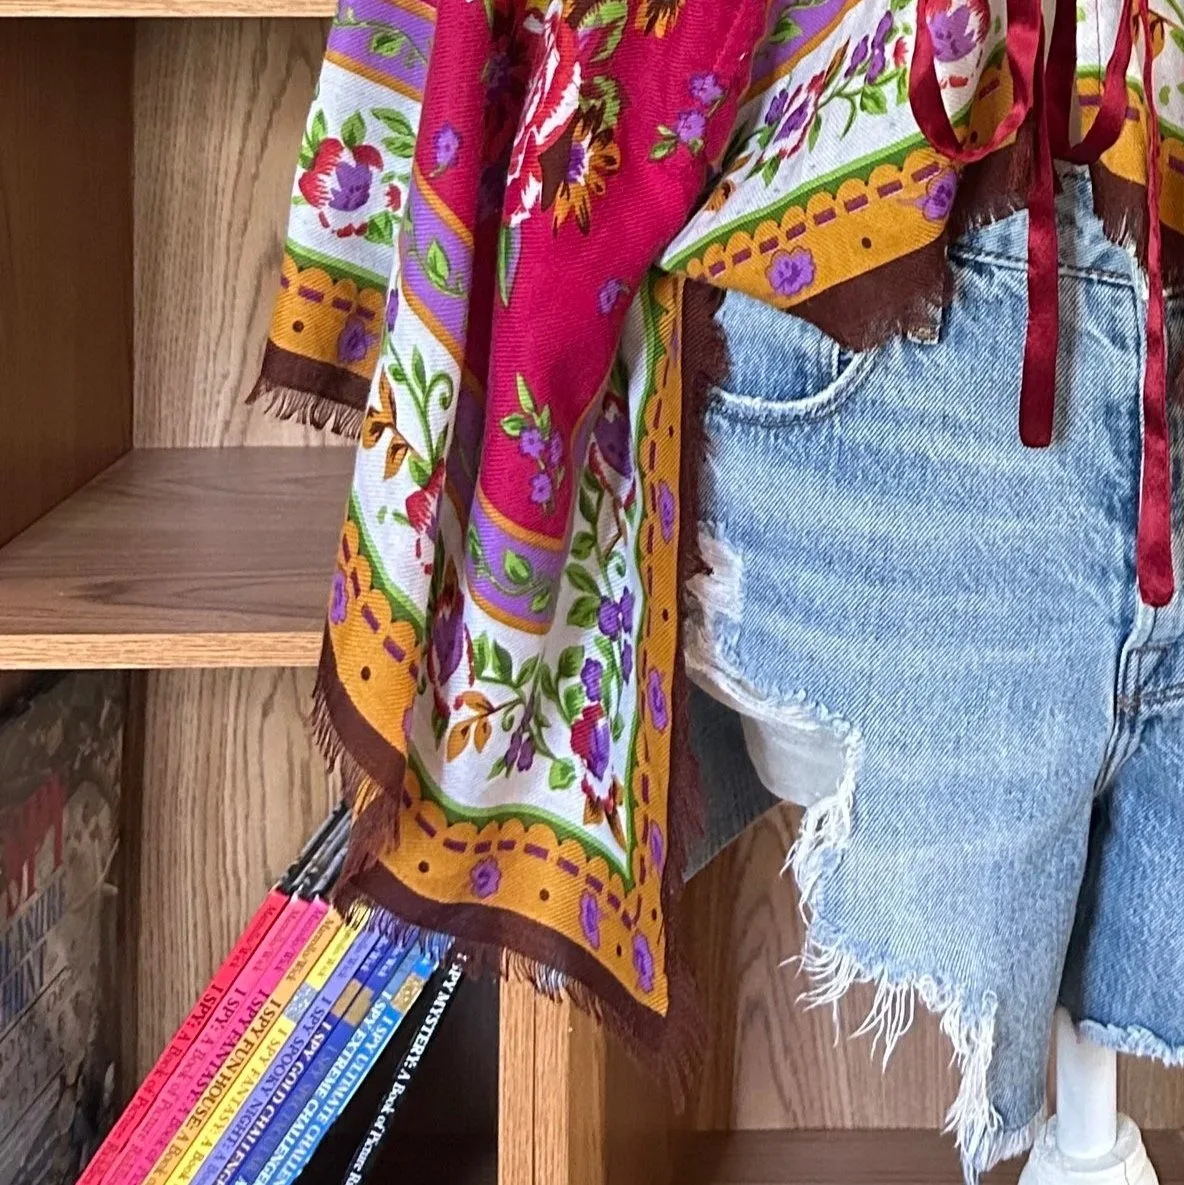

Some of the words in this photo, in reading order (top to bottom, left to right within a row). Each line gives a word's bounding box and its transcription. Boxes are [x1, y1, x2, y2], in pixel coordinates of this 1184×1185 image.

[233, 986, 246, 998] I
[269, 997, 282, 1009] I
[320, 995, 332, 1006] I
[381, 989, 393, 1000] I
[209, 995, 240, 1034] SPY:
[237, 996, 264, 1029] SPY
[248, 1005, 276, 1039] SPY
[298, 1004, 326, 1037] SPY
[321, 1020, 332, 1030] I
[361, 998, 387, 1030] SPY
[381, 1015, 394, 1026] I
[277, 1026, 288, 1037] I
[300, 1030, 326, 1062] SPY
[361, 1022, 389, 1056] SPY
[401, 991, 452, 1070] MYSTERY:
[224, 1036, 255, 1075] FUN
[255, 1036, 282, 1068] SPY
[257, 1035, 304, 1098] SPOOKY
[312, 1027, 367, 1101] EXTREME
[270, 1059, 306, 1106] GOLD
[315, 1051, 369, 1126] ULTIMATE
[396, 1068, 411, 1083] A
[184, 1071, 231, 1133] HOUSE:
[209, 1066, 261, 1136] FANTASY:
[379, 1080, 406, 1116] Book
[176, 1129, 192, 1145] A
[373, 1114, 389, 1131] of
[200, 1134, 215, 1150] A
